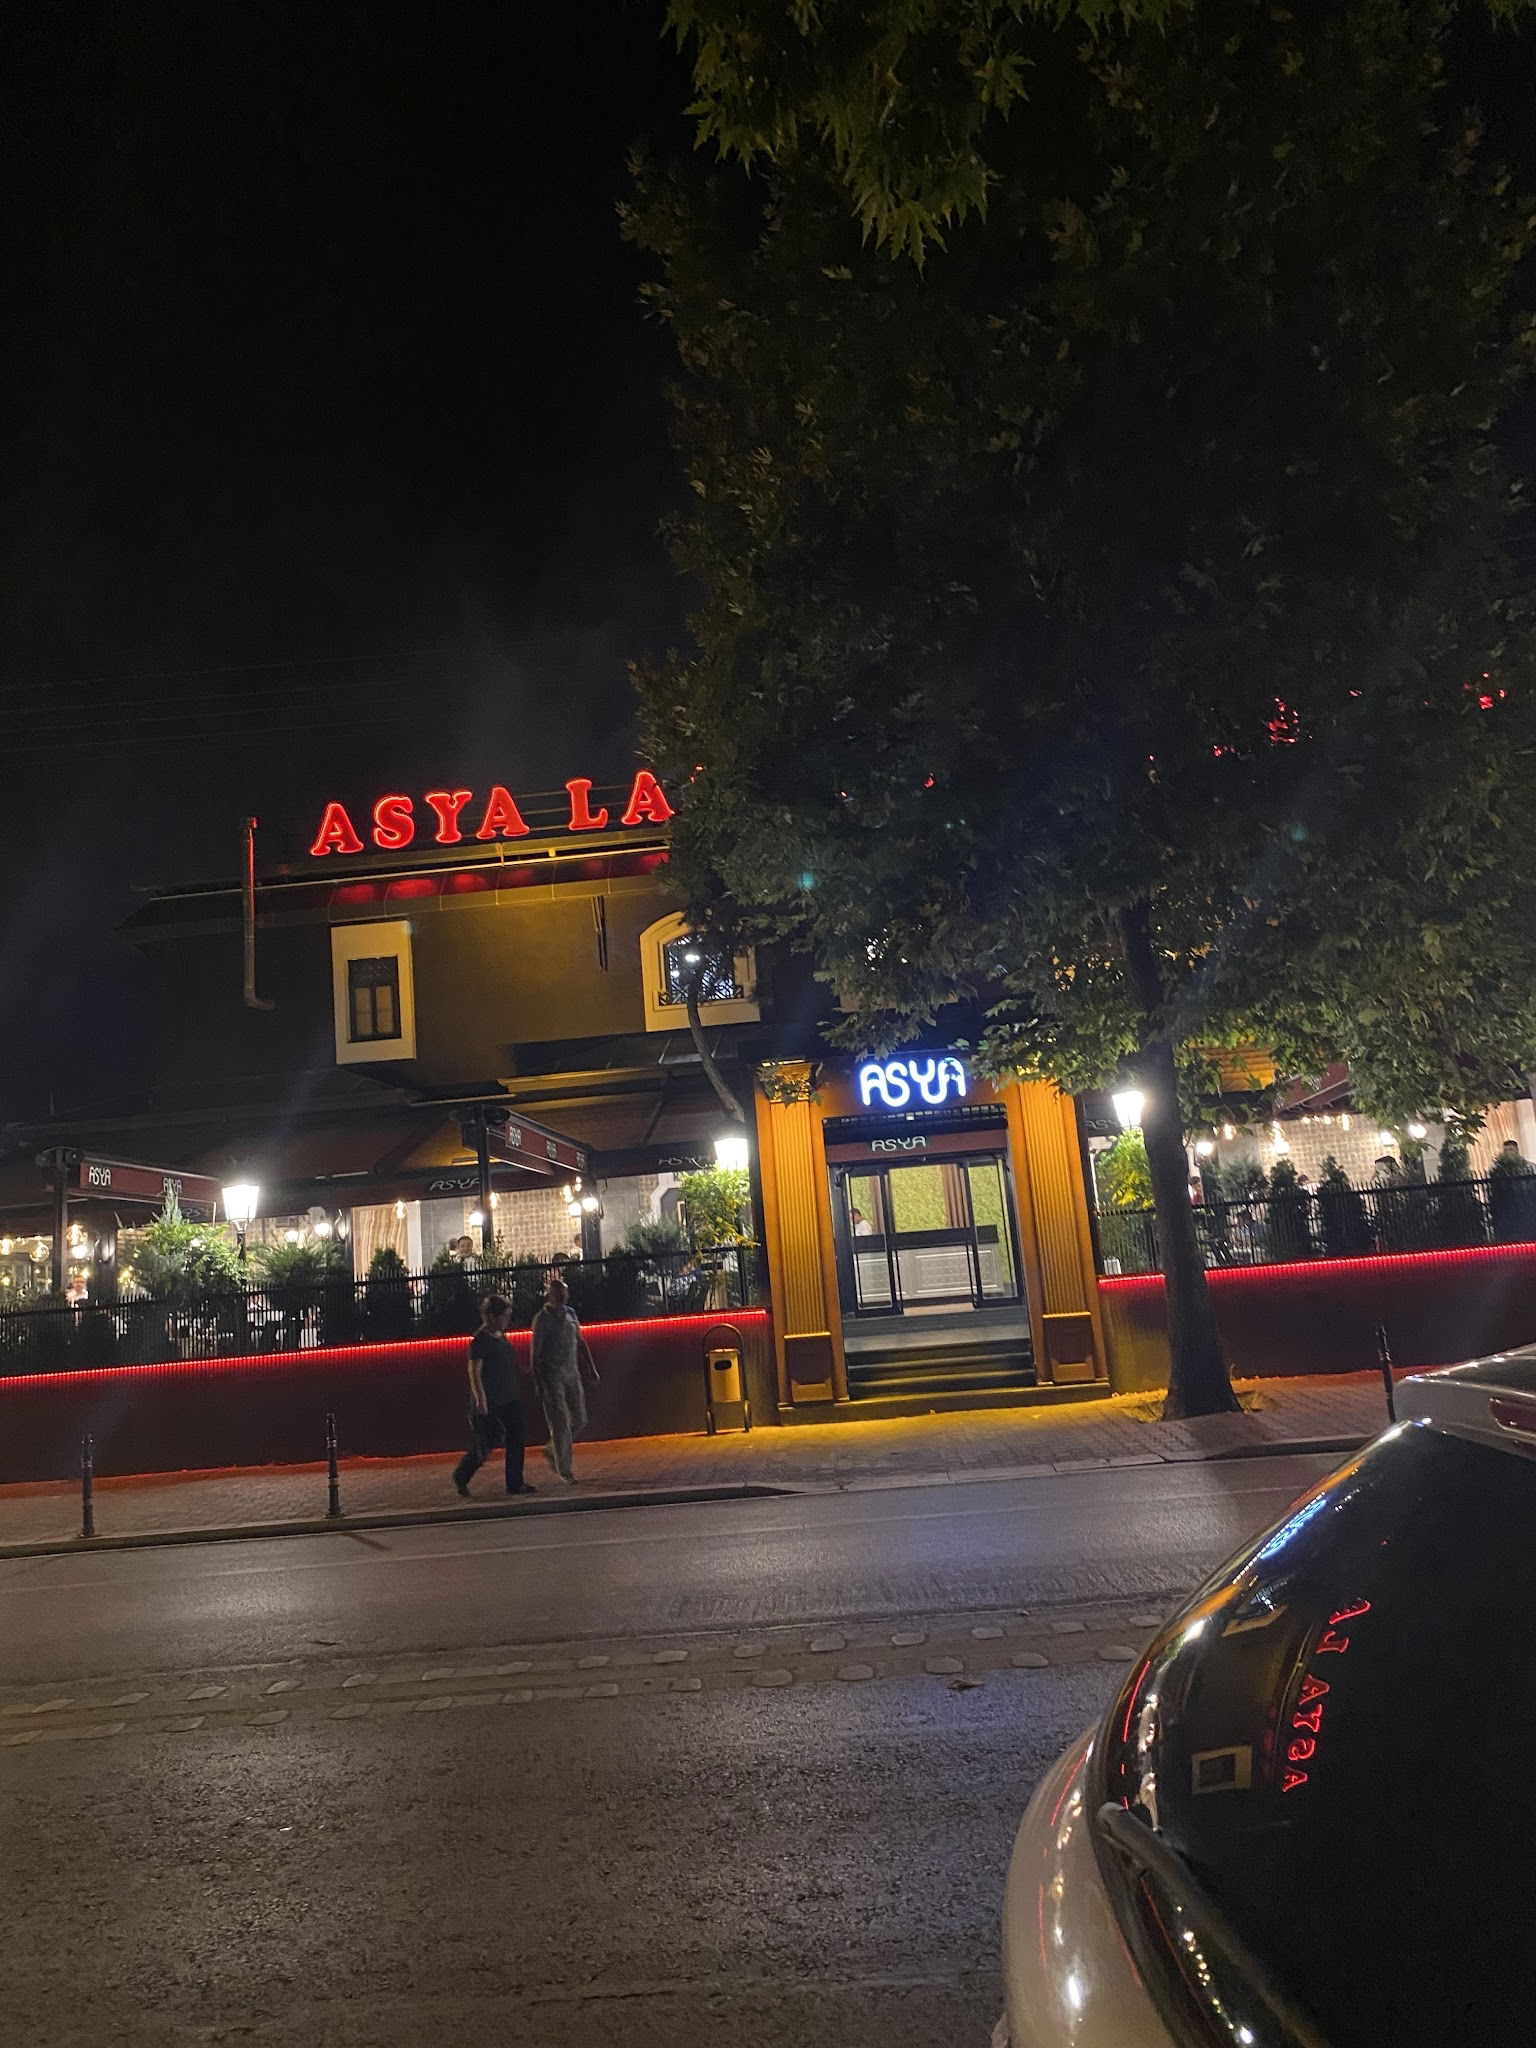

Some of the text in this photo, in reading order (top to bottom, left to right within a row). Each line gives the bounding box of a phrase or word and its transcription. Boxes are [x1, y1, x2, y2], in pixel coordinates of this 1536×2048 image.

[310, 785, 530, 856] ASYA
[859, 1057, 967, 1108] ASYA
[871, 1136, 927, 1152] ASYA
[88, 1165, 112, 1187] ASYA
